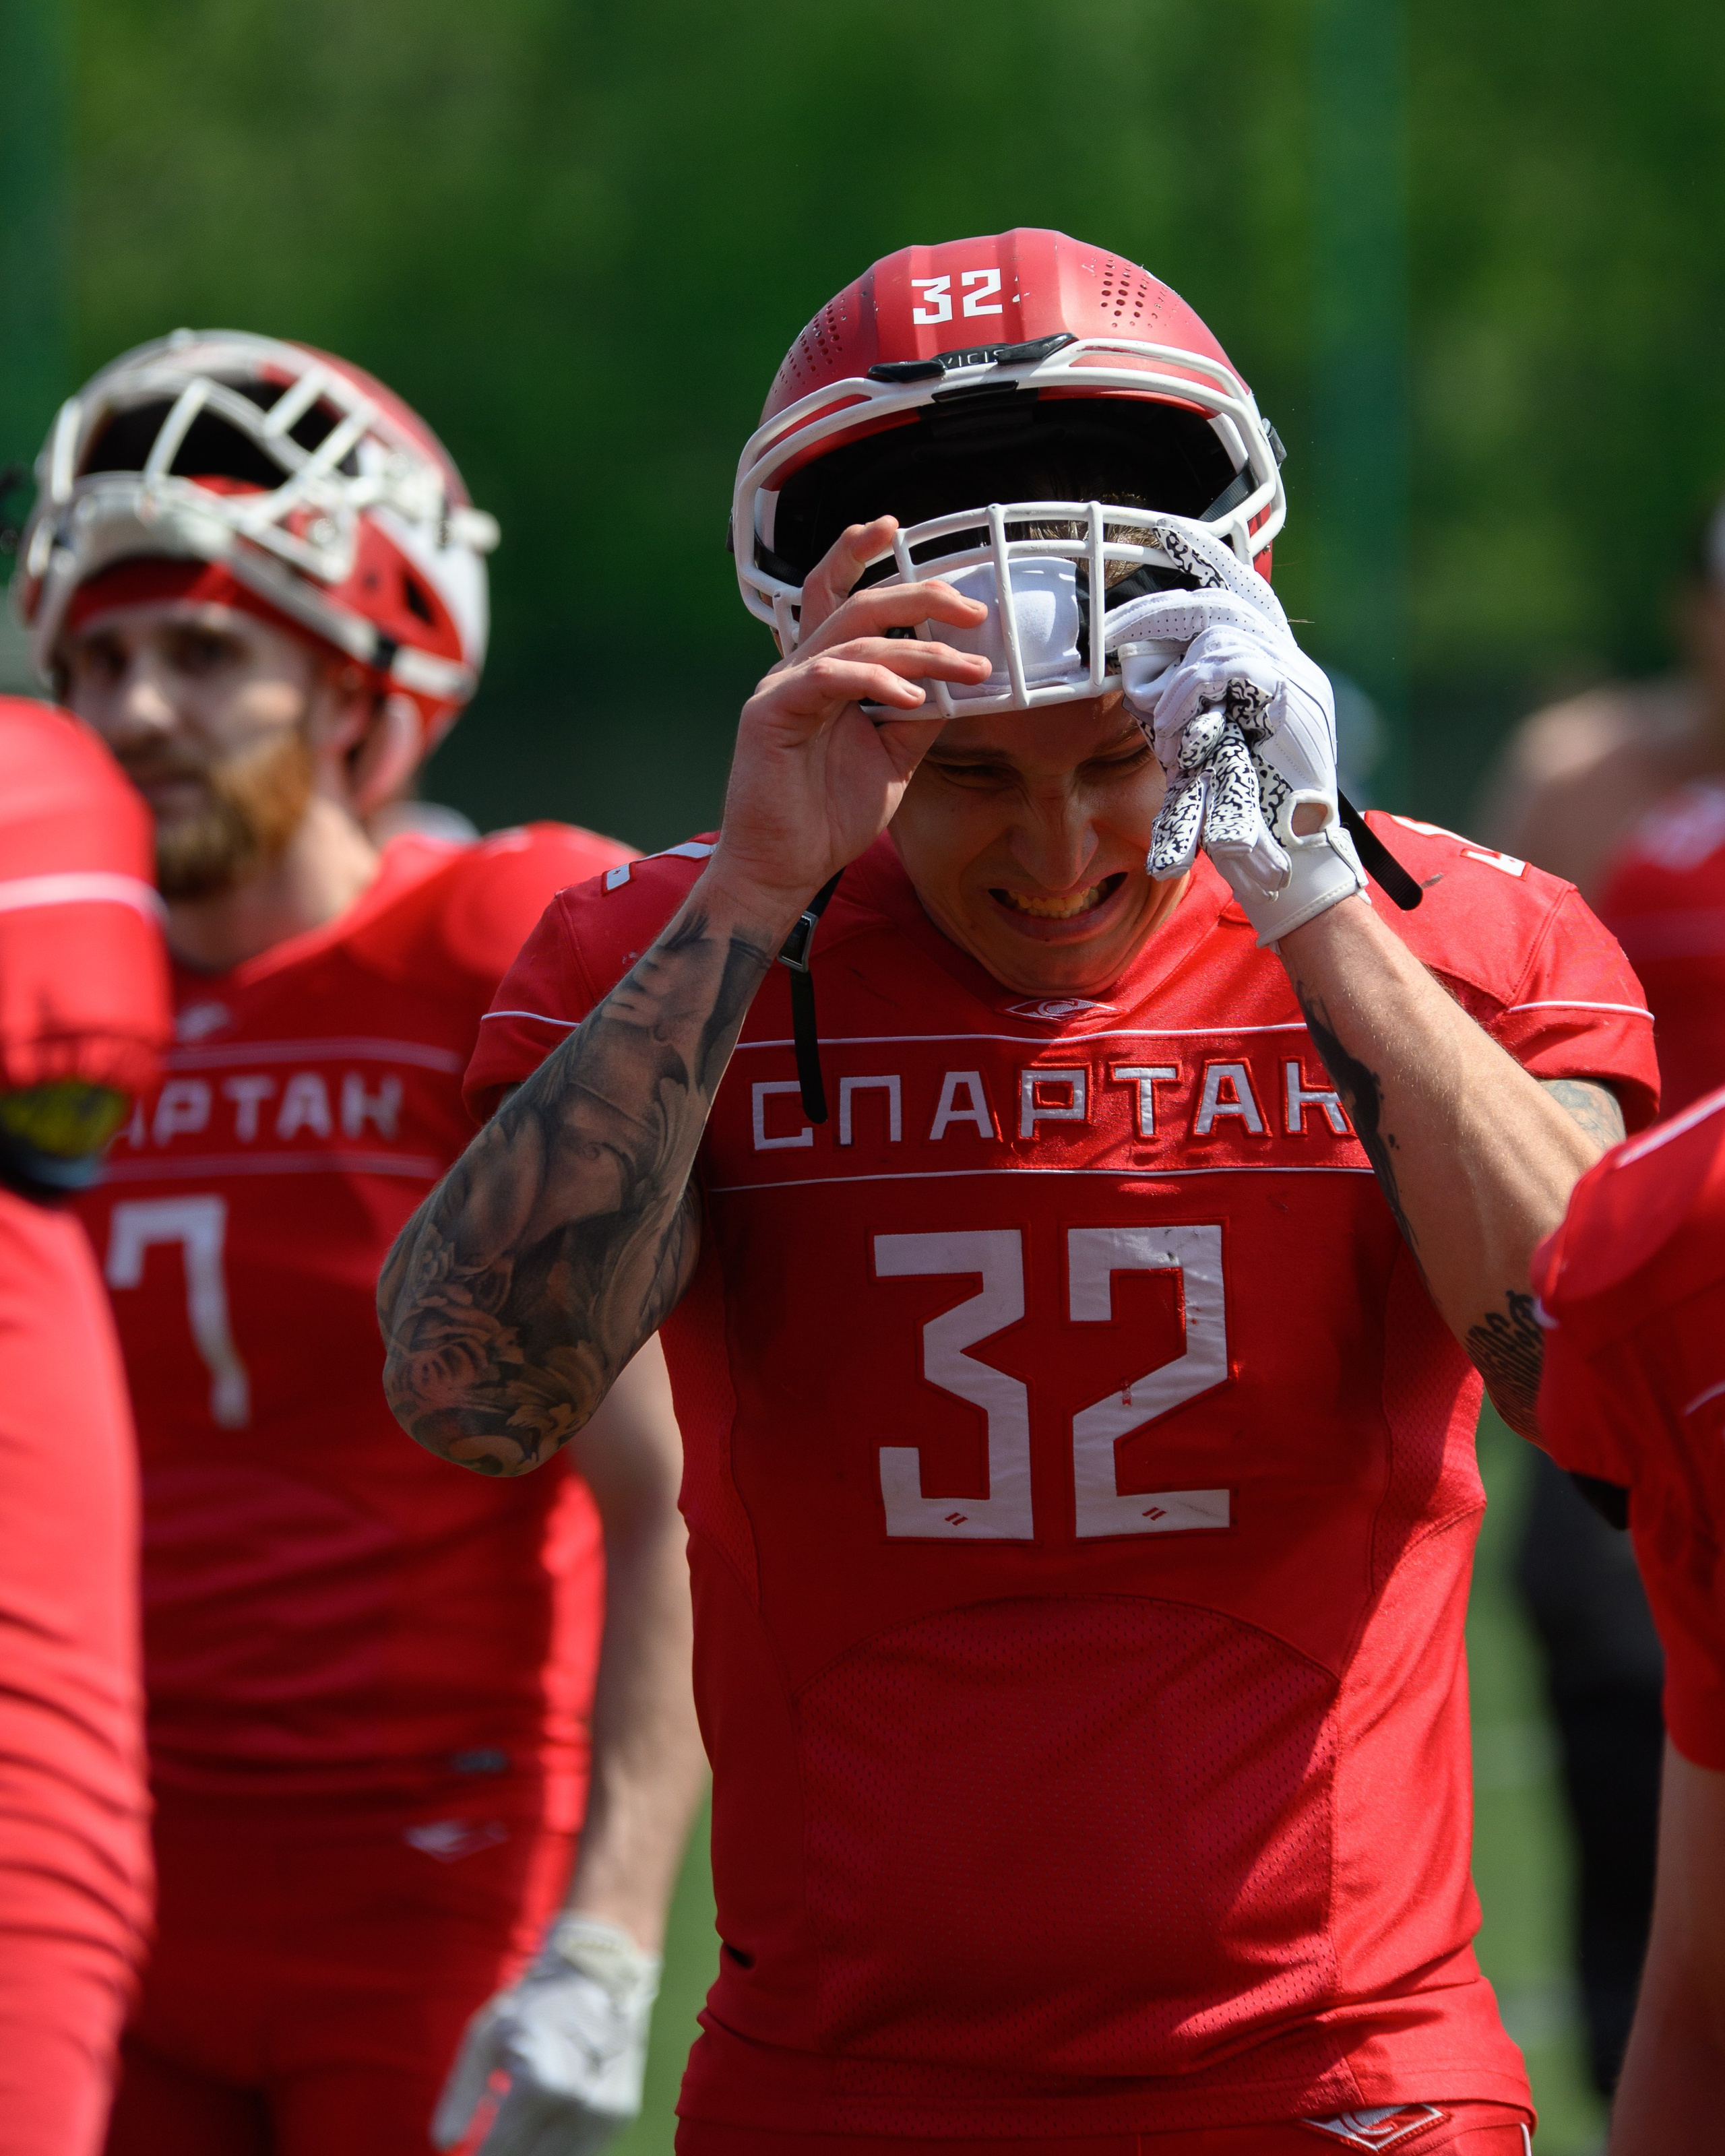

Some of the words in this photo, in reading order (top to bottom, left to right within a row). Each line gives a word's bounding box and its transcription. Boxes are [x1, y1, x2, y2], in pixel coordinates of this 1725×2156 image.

[911, 268, 1003, 325] 32
[752, 1061, 1349, 1151] СПАРТАК
[106, 1192, 250, 1431] 7
[873, 1224, 1231, 1541] 32
